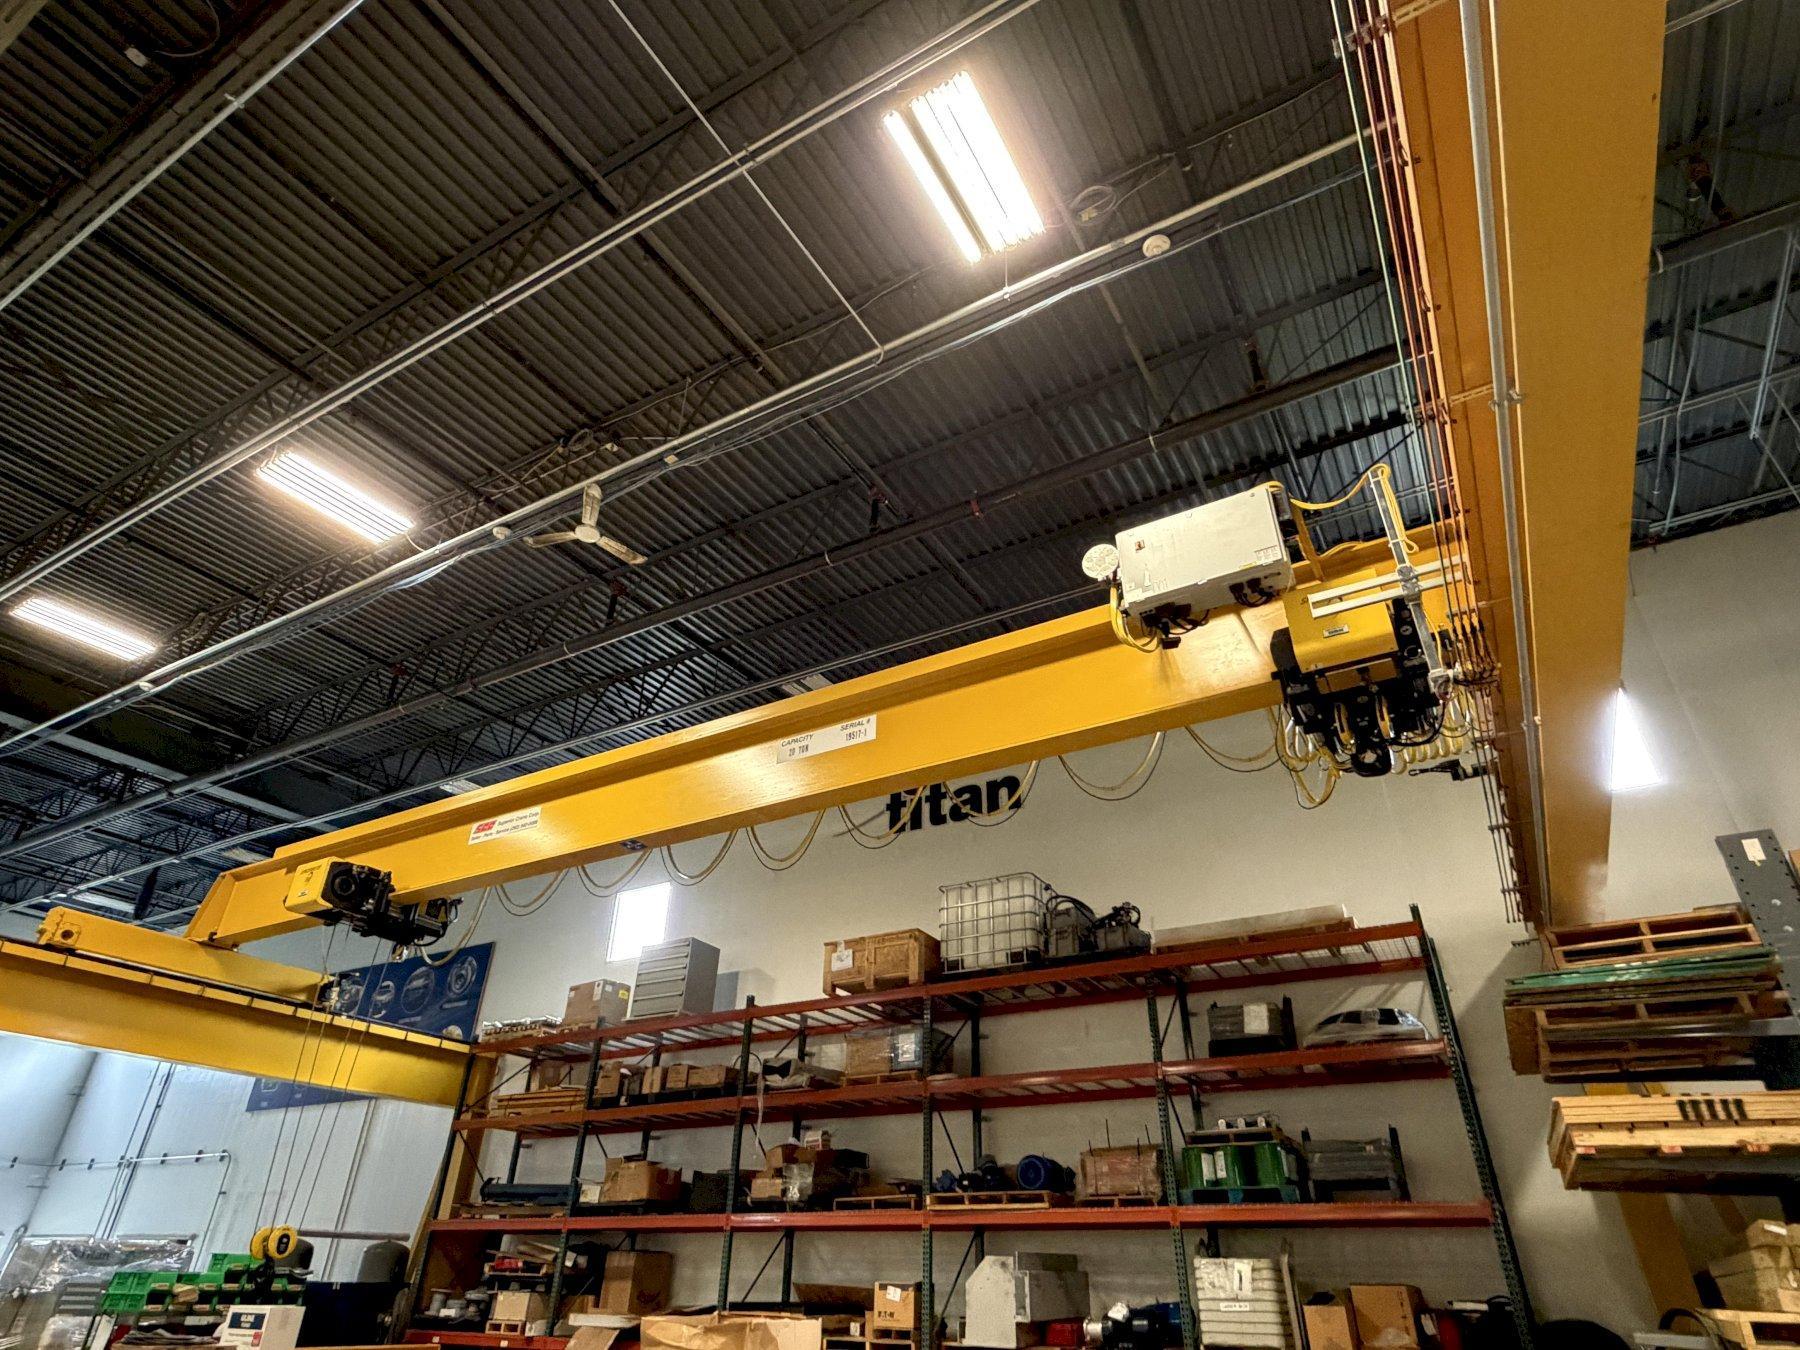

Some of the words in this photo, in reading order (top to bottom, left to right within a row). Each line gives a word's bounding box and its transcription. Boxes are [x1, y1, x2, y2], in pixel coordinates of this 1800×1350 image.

[841, 720, 865, 731] SERIAL
[781, 734, 814, 748] CAPACITY
[885, 775, 1022, 834] titan
